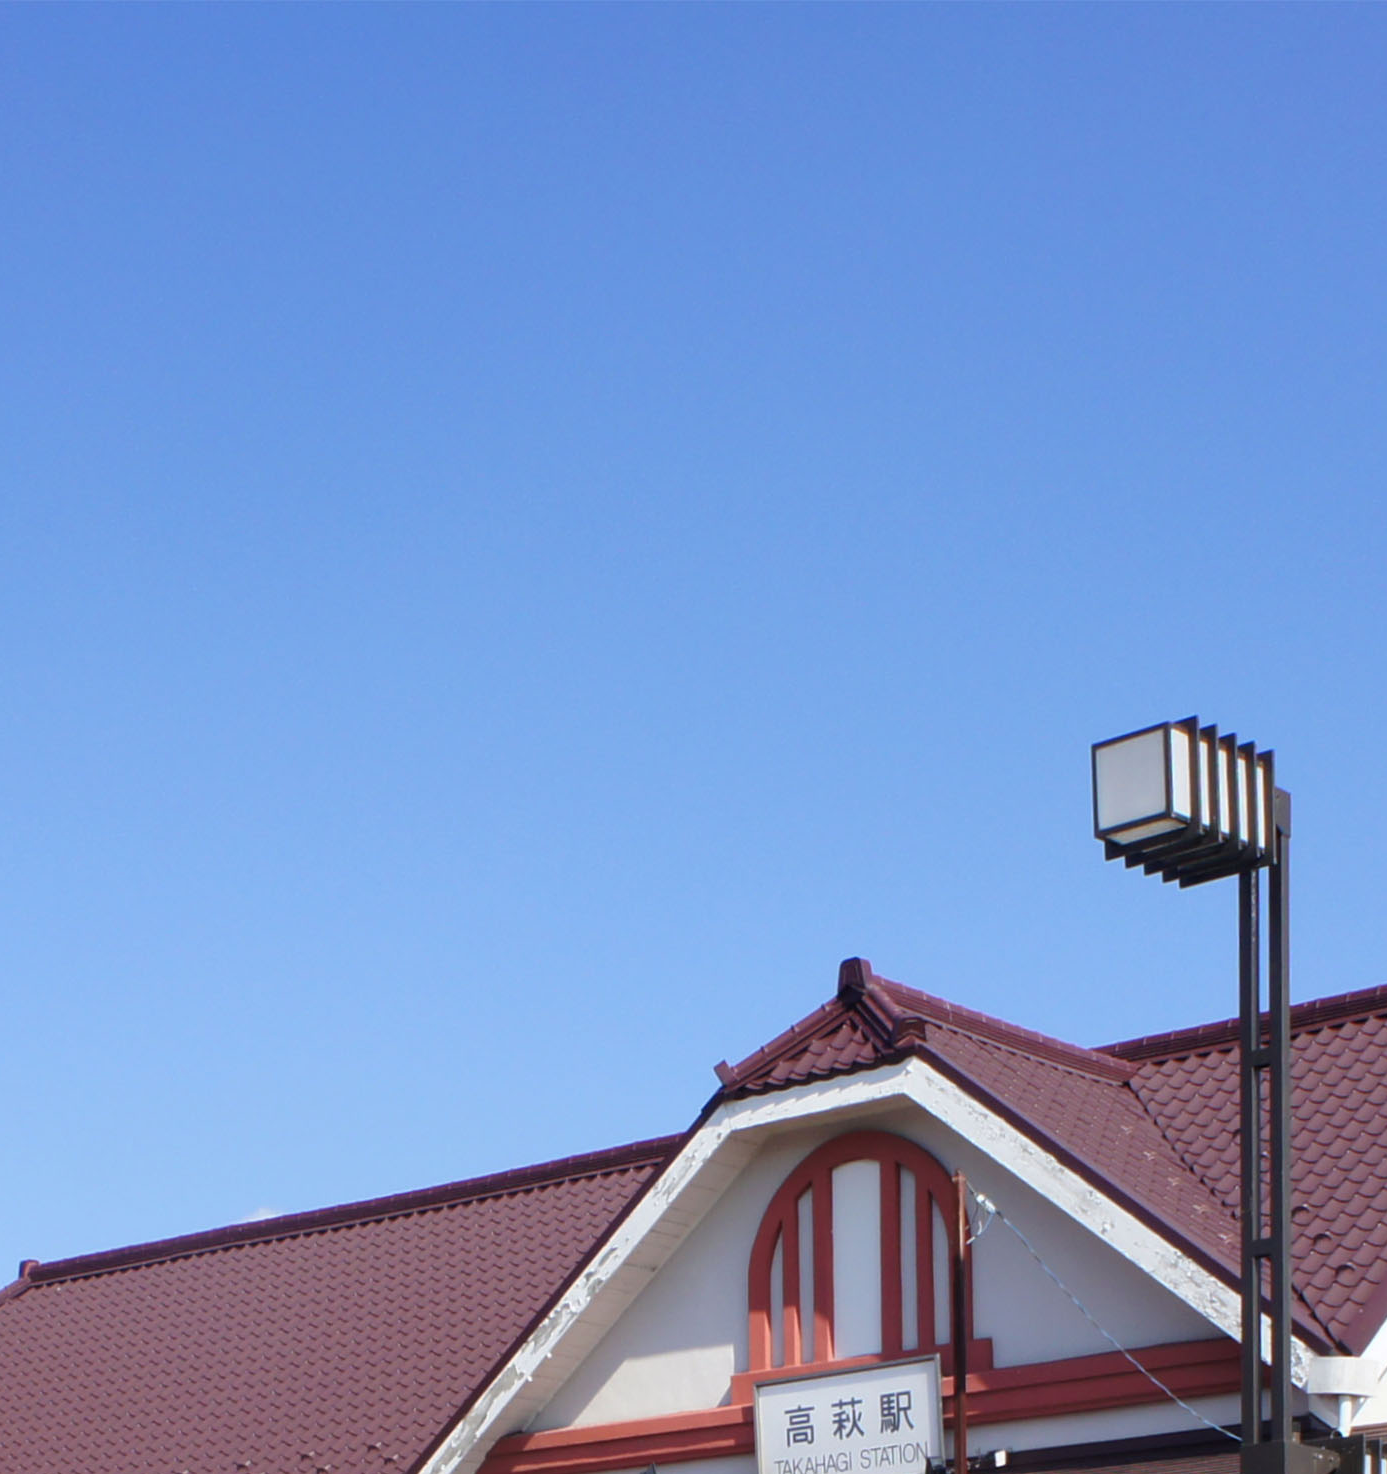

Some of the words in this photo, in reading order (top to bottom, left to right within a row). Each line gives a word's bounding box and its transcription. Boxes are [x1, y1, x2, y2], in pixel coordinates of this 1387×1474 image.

[783, 1389, 915, 1448] 高萩駅
[860, 1441, 929, 1469] STATION
